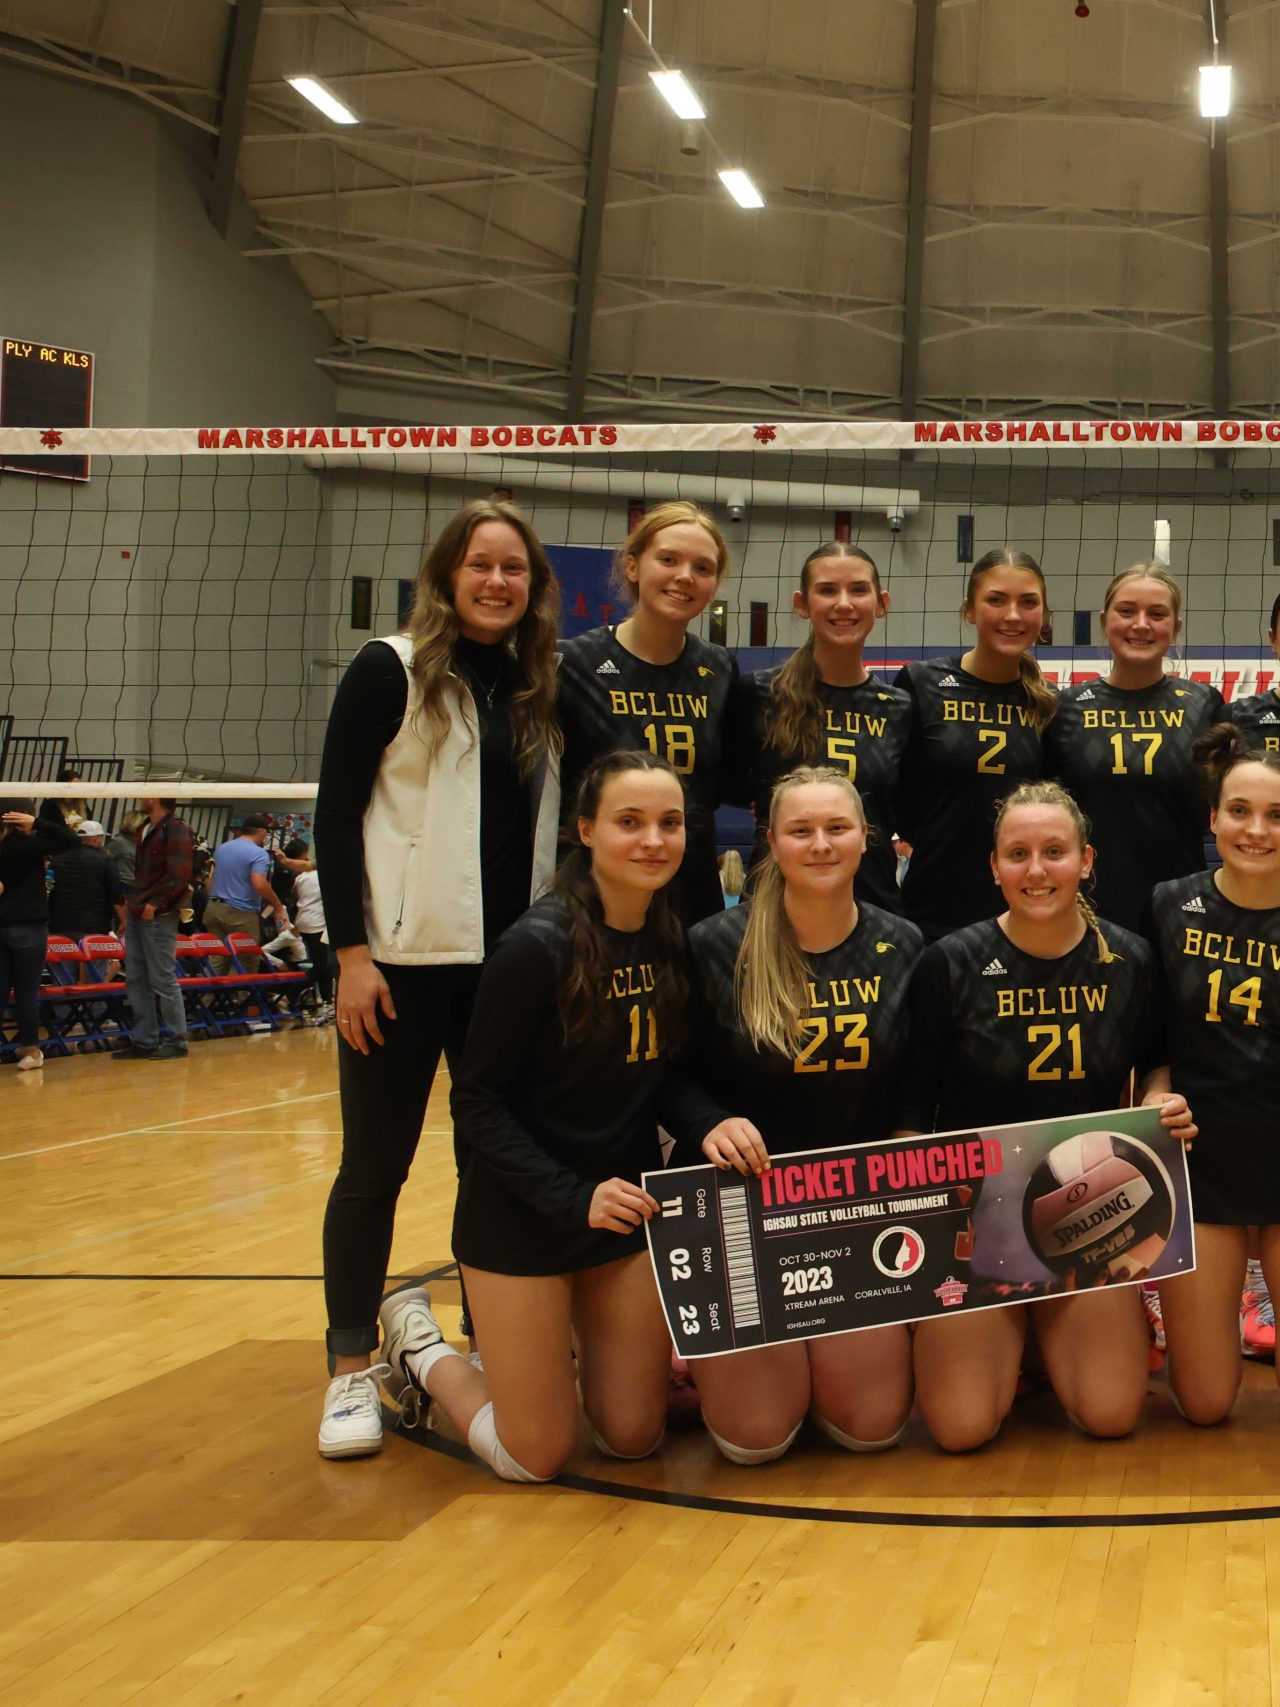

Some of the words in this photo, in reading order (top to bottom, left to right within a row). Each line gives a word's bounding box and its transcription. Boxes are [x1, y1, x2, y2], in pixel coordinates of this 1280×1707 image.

[5, 341, 32, 358] PLY
[40, 348, 57, 362] AC
[63, 351, 89, 368] KLS
[198, 428, 457, 448] MARSHALLTOWN
[470, 425, 617, 446] BOBCATS
[914, 421, 1182, 442] MARSHALLTOWN
[596, 667, 620, 675] adidas
[609, 690, 708, 719] BCLUW
[943, 700, 1037, 728] BCLUW
[1083, 709, 1185, 728] BCLUW
[825, 709, 887, 738] LUW
[644, 723, 695, 775] 18
[827, 737, 857, 784] 5
[977, 729, 1007, 775] 2
[1110, 732, 1163, 775] 17
[1182, 903, 1206, 914] adidas
[606, 963, 656, 999] CLU
[981, 968, 1008, 976] adidas
[807, 975, 881, 1009] LUW
[997, 985, 1108, 1017] BCLUW
[1205, 968, 1262, 1027] 14
[626, 1004, 659, 1063] 11
[794, 1013, 870, 1073] 23
[1027, 1023, 1086, 1081] 21
[757, 1158, 856, 1207] TICKET
[866, 1139, 1003, 1192] PUNCHED
[662, 1196, 683, 1218] 11
[696, 1188, 706, 1218] Gate
[763, 1214, 798, 1232] IGHSAU
[800, 1209, 829, 1227] STATE
[831, 1201, 886, 1222] VOLLEYBALL
[888, 1193, 949, 1213] TOURNAMENT
[1054, 1191, 1131, 1248] SPALDING
[669, 1248, 692, 1281] 02
[701, 1247, 712, 1273] Row
[779, 1256, 800, 1266] OCT
[802, 1249, 843, 1262] 30-NOV
[845, 1246, 852, 1256] 2
[781, 1266, 834, 1296] 2023
[854, 1285, 902, 1300] CORALVILLE,
[903, 1283, 912, 1292] IA
[708, 1303, 721, 1332] Seat
[785, 1300, 817, 1311] XTREAM
[818, 1295, 845, 1306] ARENA
[678, 1304, 701, 1336] 23
[786, 1317, 826, 1330] IGHSAU.ORG
